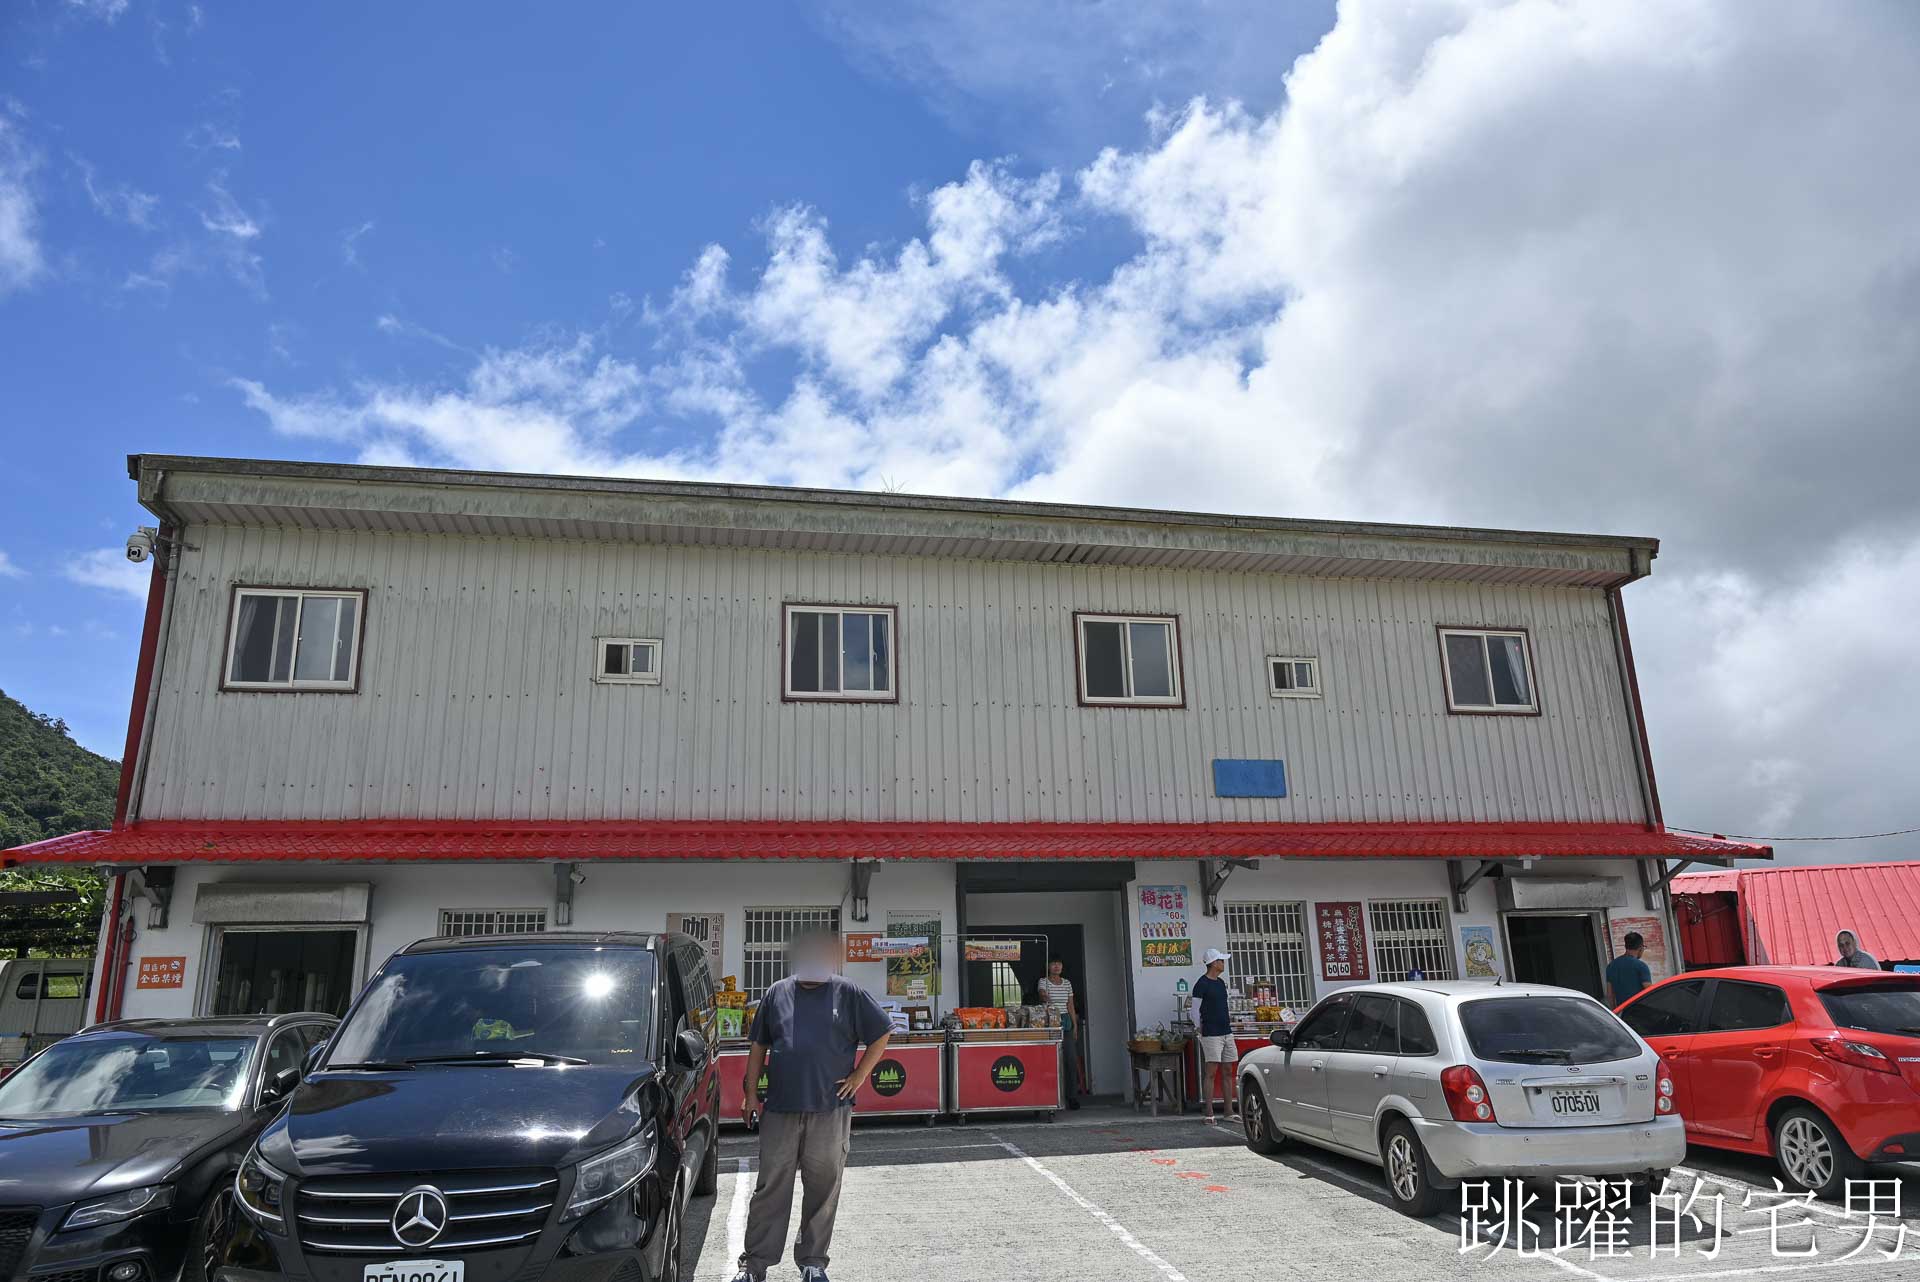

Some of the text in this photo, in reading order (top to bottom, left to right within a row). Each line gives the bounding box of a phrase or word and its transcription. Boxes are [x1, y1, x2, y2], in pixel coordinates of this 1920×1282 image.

[848, 949, 872, 958] 全面禁
[1145, 942, 1179, 955] 金針冰
[143, 963, 167, 971] 園區內
[1328, 964, 1338, 974] 60
[1340, 964, 1349, 974] 60
[140, 973, 181, 984] 全面禁煙
